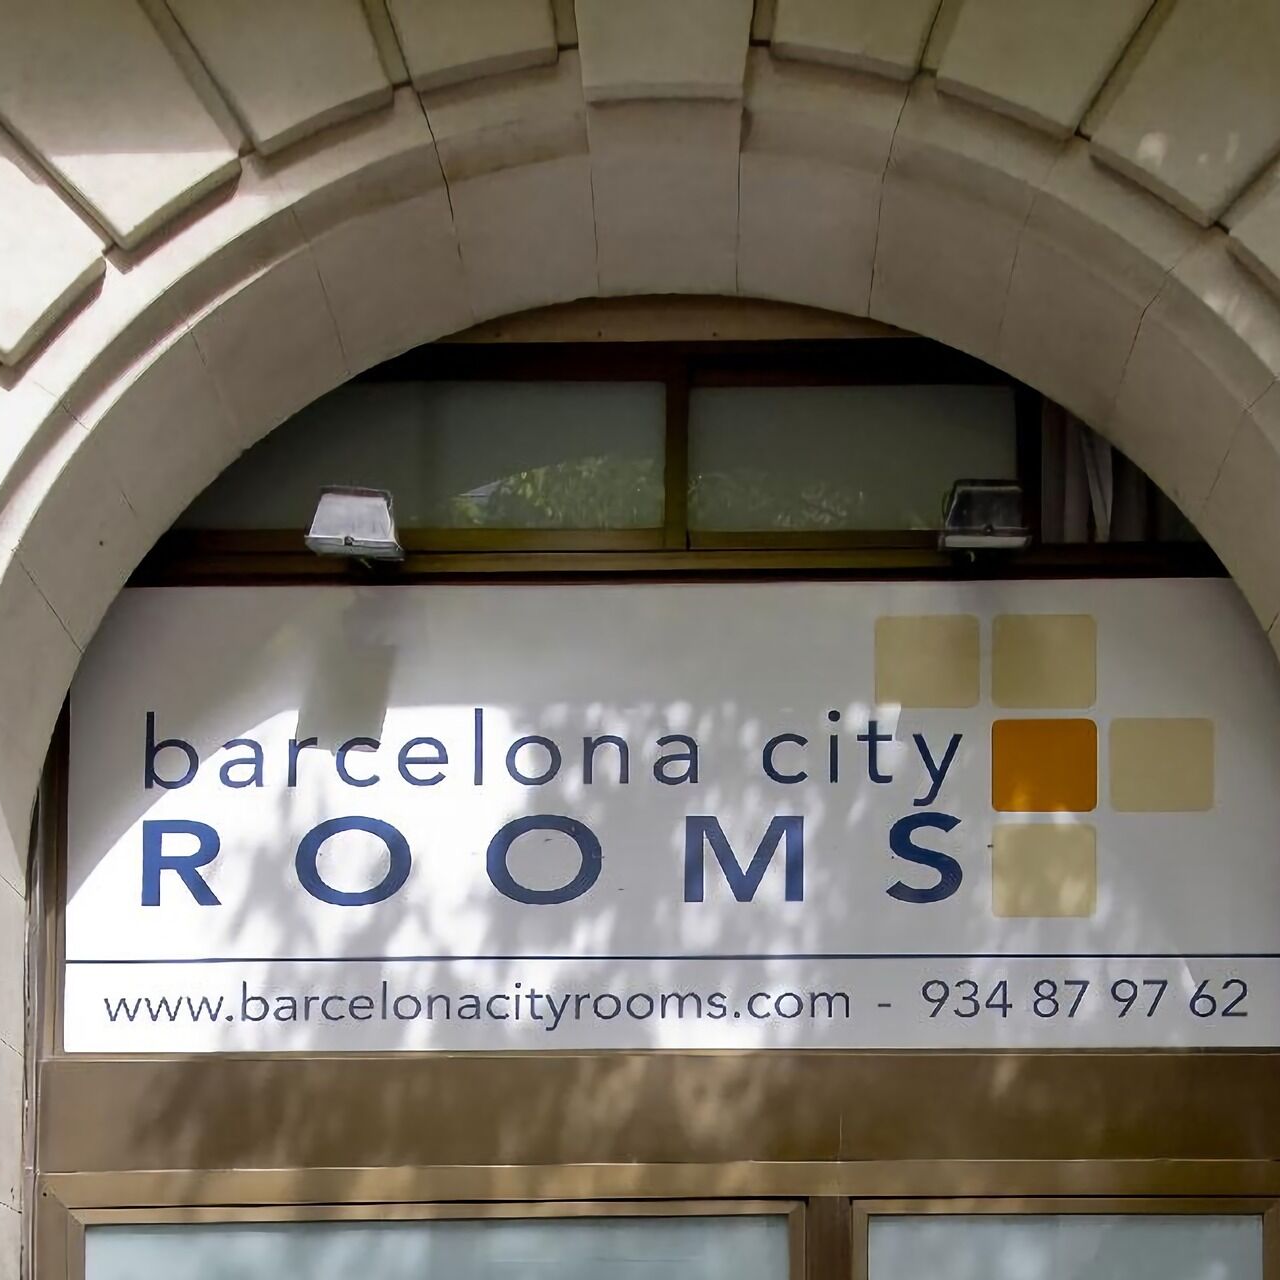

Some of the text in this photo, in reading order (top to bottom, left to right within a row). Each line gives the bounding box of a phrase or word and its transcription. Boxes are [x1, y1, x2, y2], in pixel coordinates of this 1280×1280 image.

[144, 707, 964, 806] barcelona city
[140, 812, 964, 907] ROOMS
[104, 981, 850, 1032] www.barcelonacityrooms.com
[921, 979, 1014, 1020] 934
[1033, 979, 1092, 1020] 87
[1111, 979, 1170, 1020] 97
[1189, 979, 1250, 1020] 62
